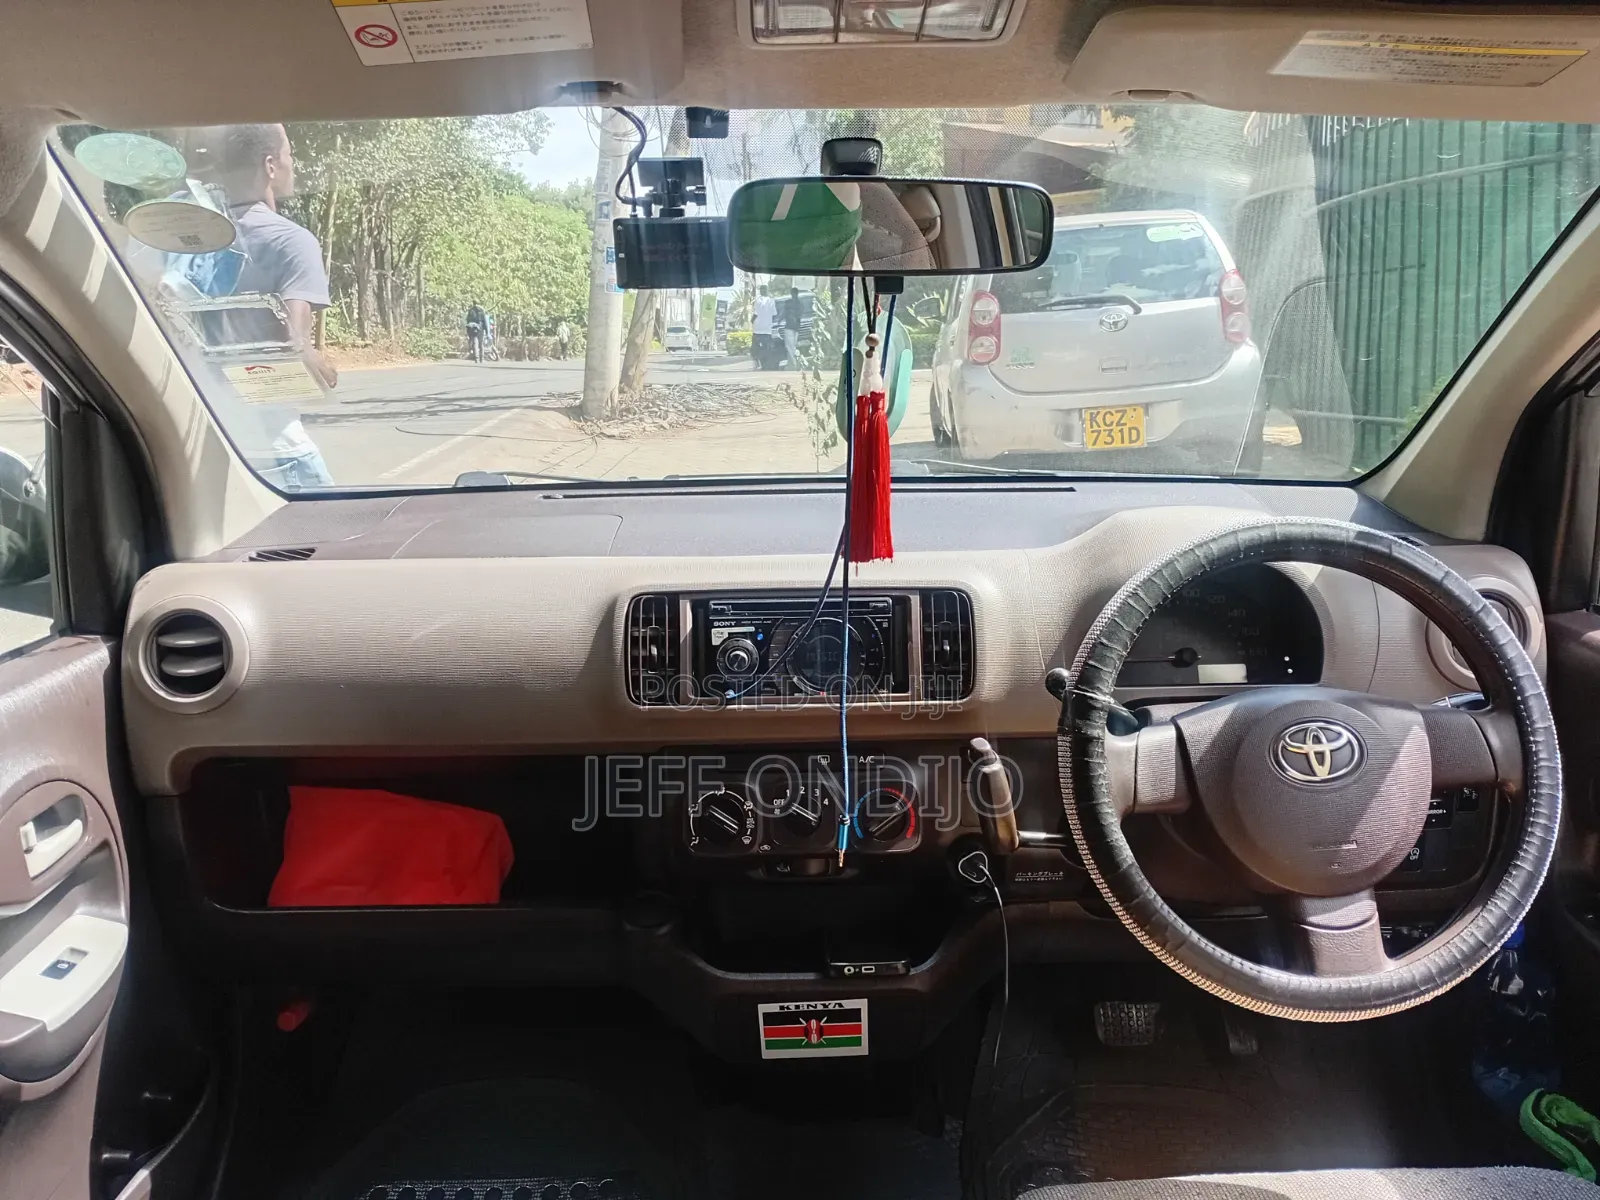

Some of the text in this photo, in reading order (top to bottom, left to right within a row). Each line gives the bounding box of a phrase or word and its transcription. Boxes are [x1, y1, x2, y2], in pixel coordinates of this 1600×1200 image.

[1089, 408, 1128, 429] KCZ
[1090, 426, 1141, 447] 731D
[859, 755, 875, 764] A/C
[800, 786, 805, 794] 2
[773, 798, 785, 806] OFF
[823, 798, 829, 806] 4
[778, 1002, 845, 1012] KENYA
